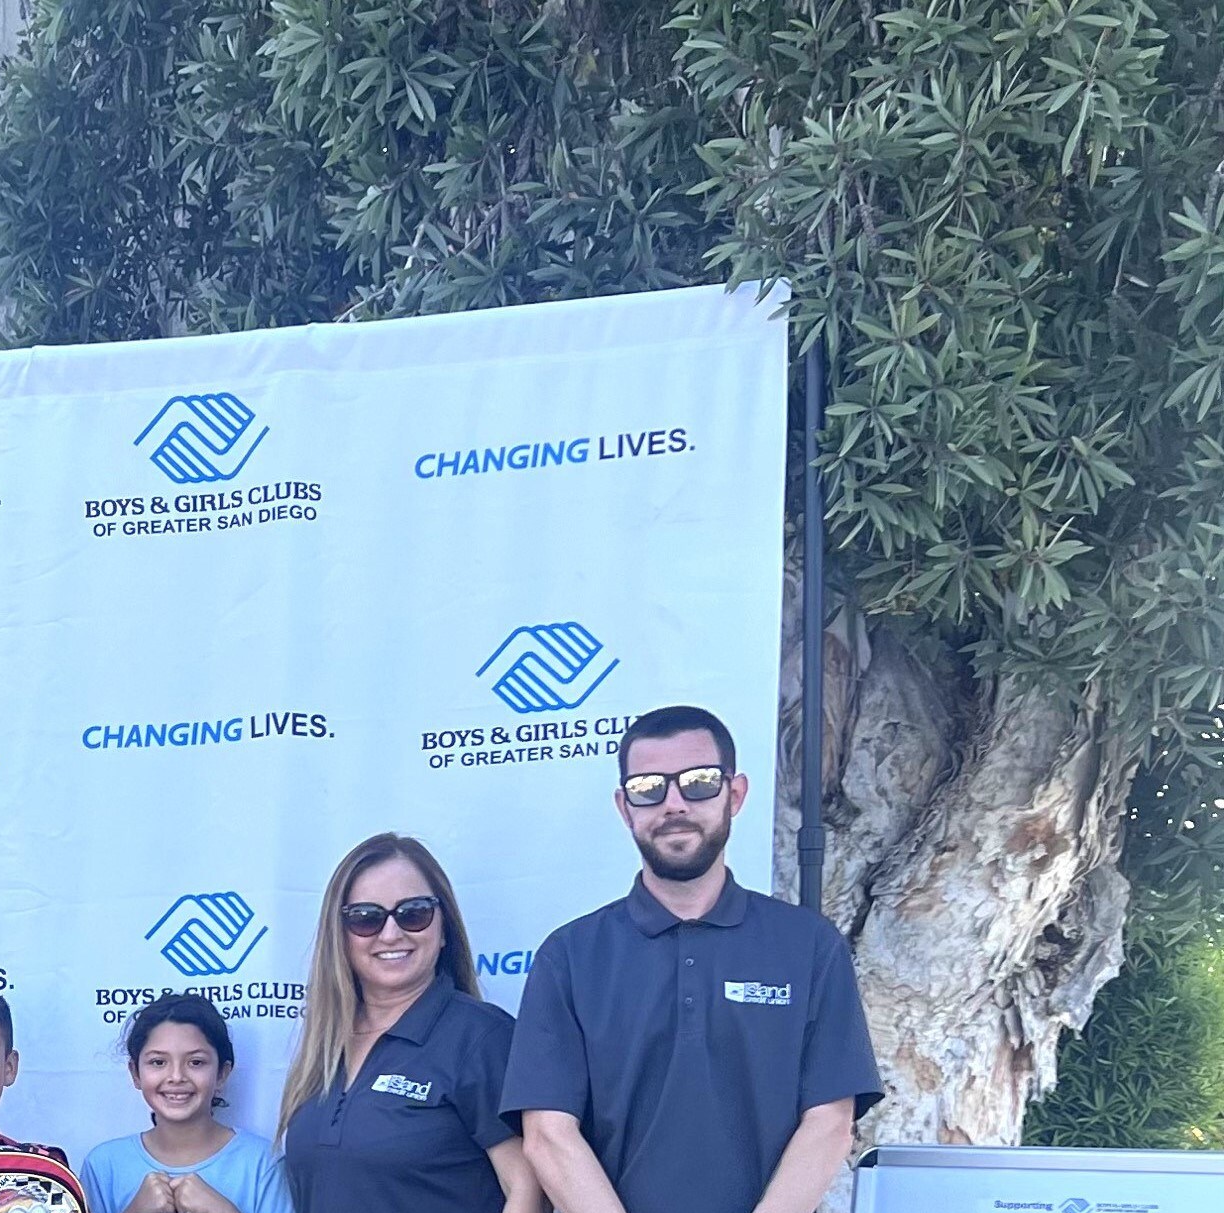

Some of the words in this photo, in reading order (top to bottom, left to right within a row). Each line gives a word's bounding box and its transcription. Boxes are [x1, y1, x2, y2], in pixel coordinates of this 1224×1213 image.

[415, 438, 589, 478] CHANGING
[600, 429, 694, 460] LIVES.
[85, 498, 144, 518] BOYS
[151, 497, 170, 514] &
[175, 491, 243, 513] GIRLS
[249, 482, 321, 504] CLUBS
[94, 523, 116, 537] OF
[123, 518, 211, 535] GREATER
[218, 512, 252, 529] SAN
[259, 505, 316, 523] DIEGO
[83, 718, 242, 749] CHANGING
[251, 712, 334, 738] LIVES.
[421, 728, 485, 750] BOYS
[491, 727, 511, 744] &
[516, 719, 588, 744] GIRLS
[430, 754, 454, 768] OF
[460, 746, 553, 767] GREATER
[560, 742, 598, 758] SAN
[96, 988, 155, 1005] BOYS
[247, 982, 305, 1001] CLUB
[103, 1010, 127, 1024] OF
[222, 1004, 251, 1020] SAN
[256, 1004, 304, 1019] DIEG
